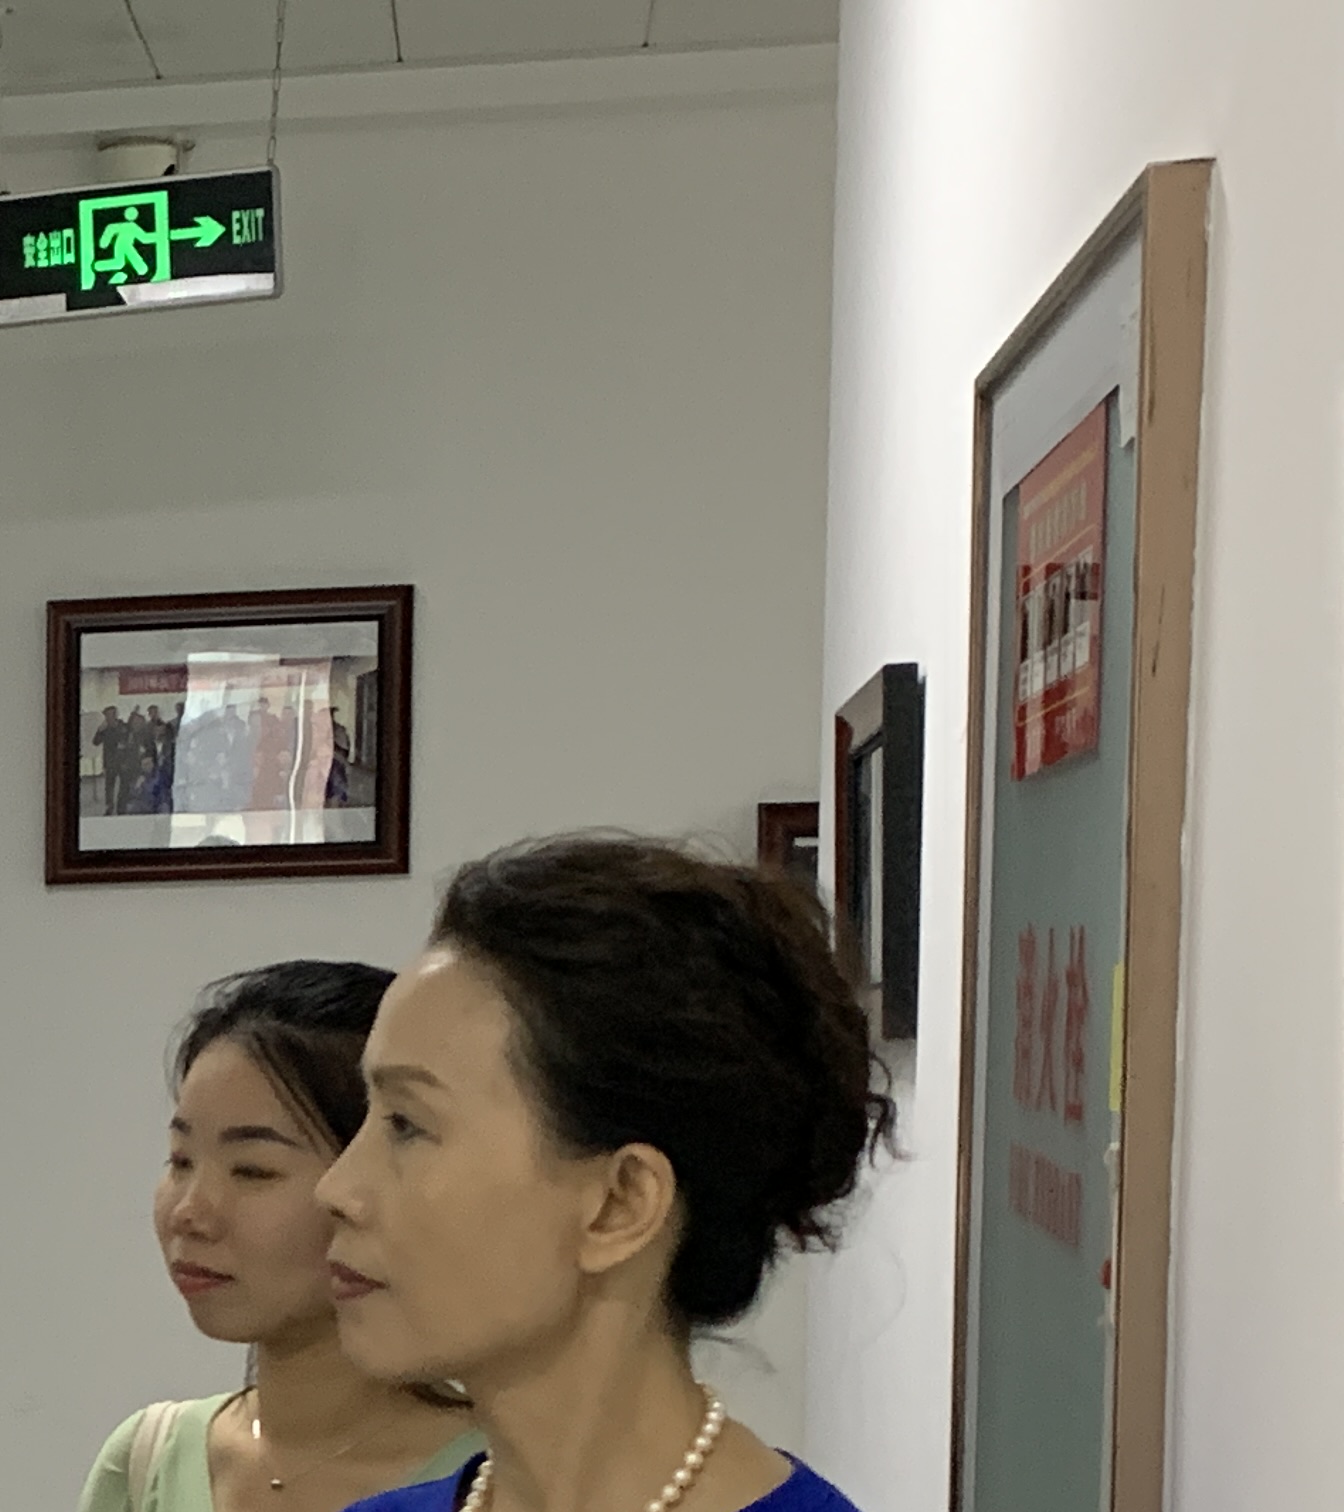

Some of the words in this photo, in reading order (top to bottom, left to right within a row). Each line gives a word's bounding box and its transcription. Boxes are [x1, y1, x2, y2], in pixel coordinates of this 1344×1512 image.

[231, 207, 265, 245] EXIT
[23, 228, 75, 269] 安全出口
